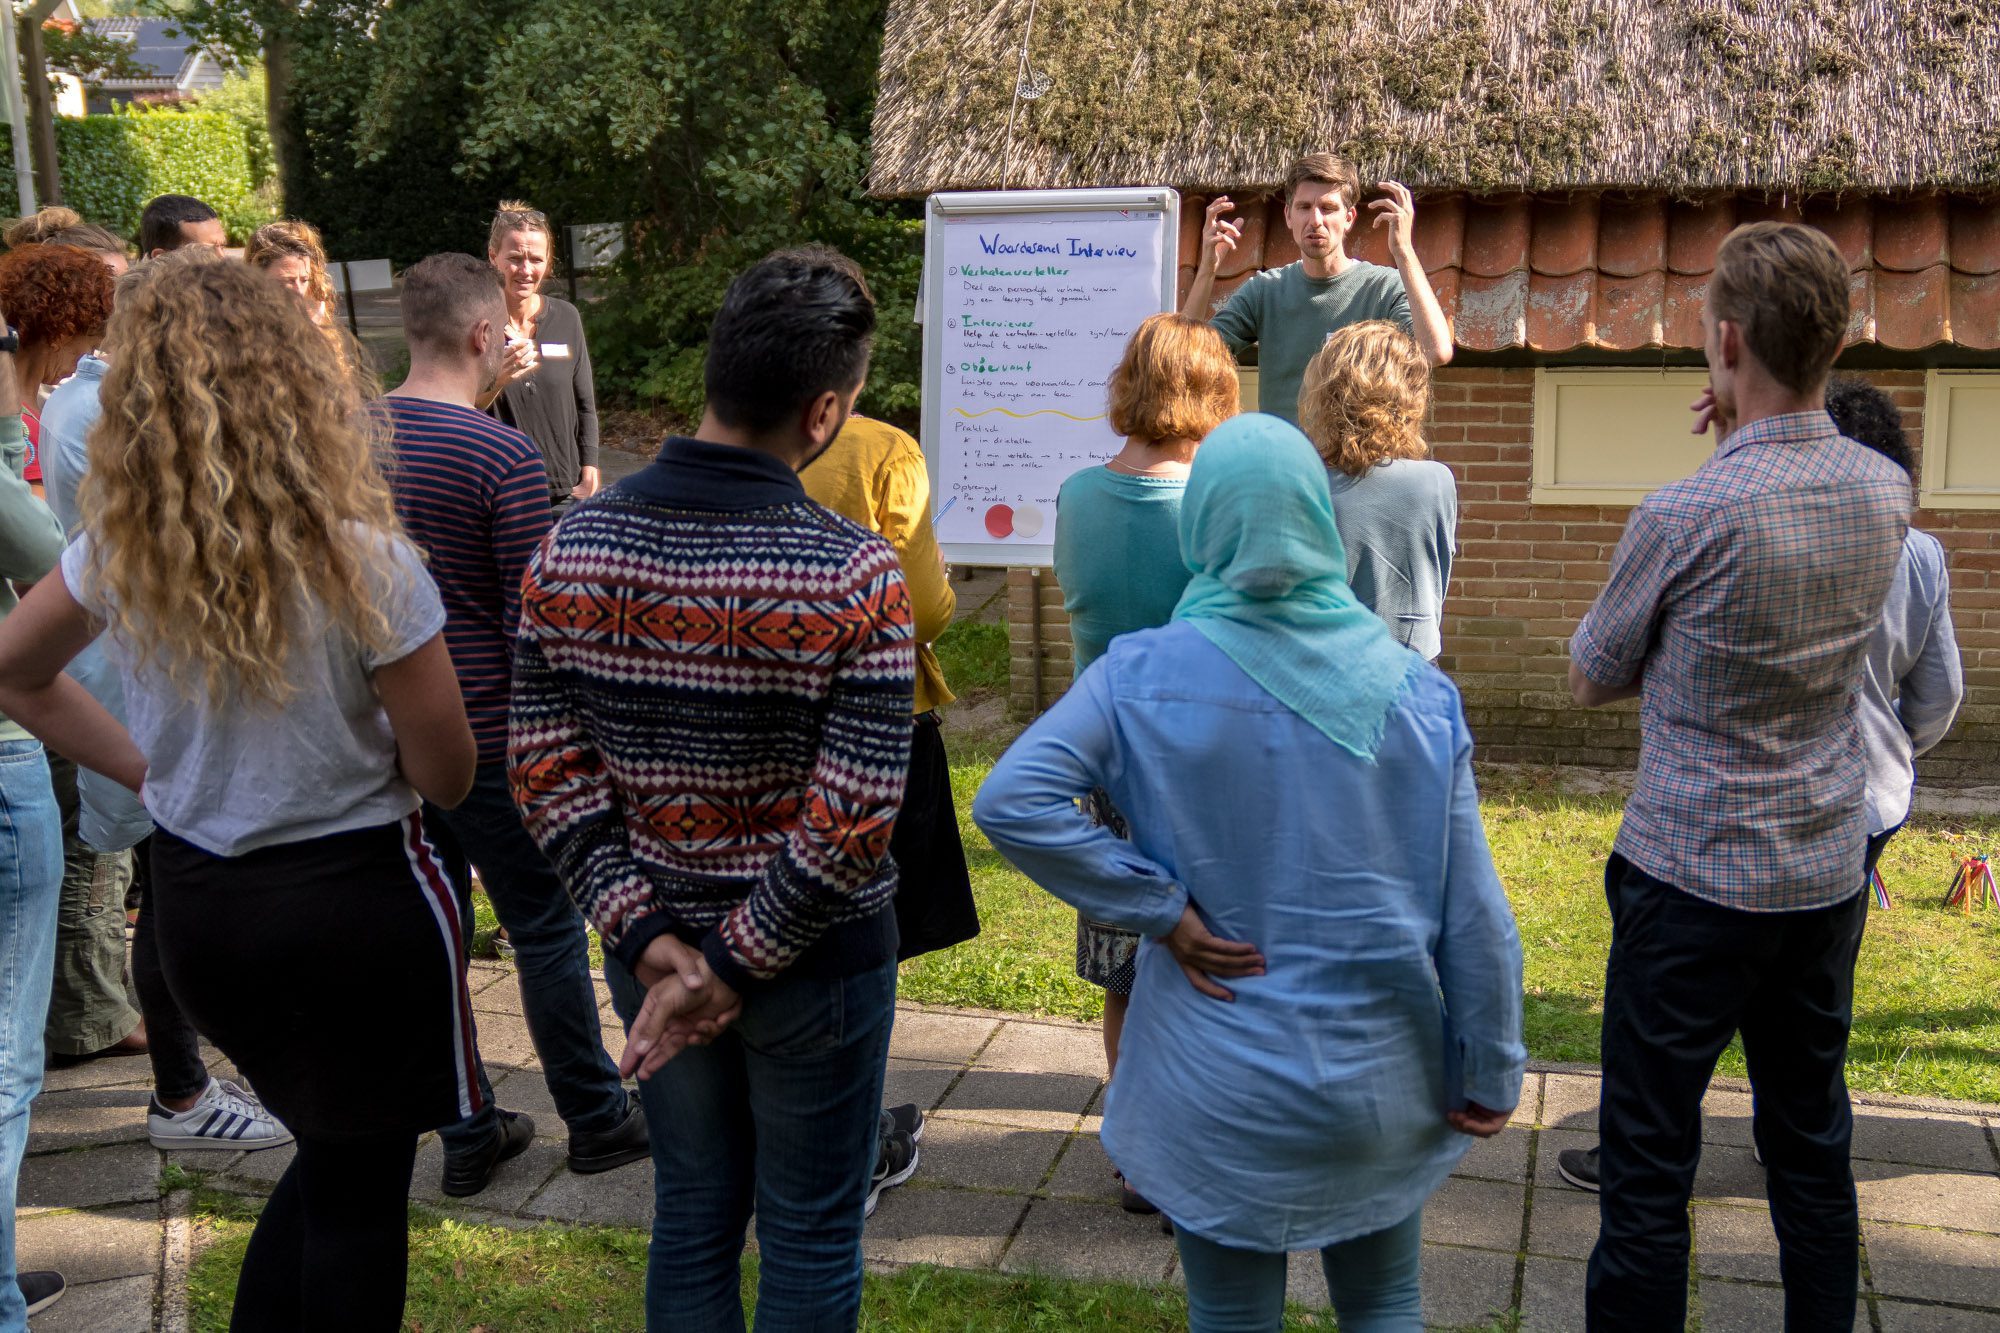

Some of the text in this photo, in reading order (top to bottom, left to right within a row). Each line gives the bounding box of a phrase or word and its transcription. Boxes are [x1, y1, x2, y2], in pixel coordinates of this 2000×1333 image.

[1066, 238, 1137, 258] Interview
[963, 280, 983, 291] Deel
[961, 314, 1034, 328] Interviewer
[1002, 340, 1011, 350] te
[955, 421, 999, 433] Praktisch
[1017, 494, 1024, 502] 2
